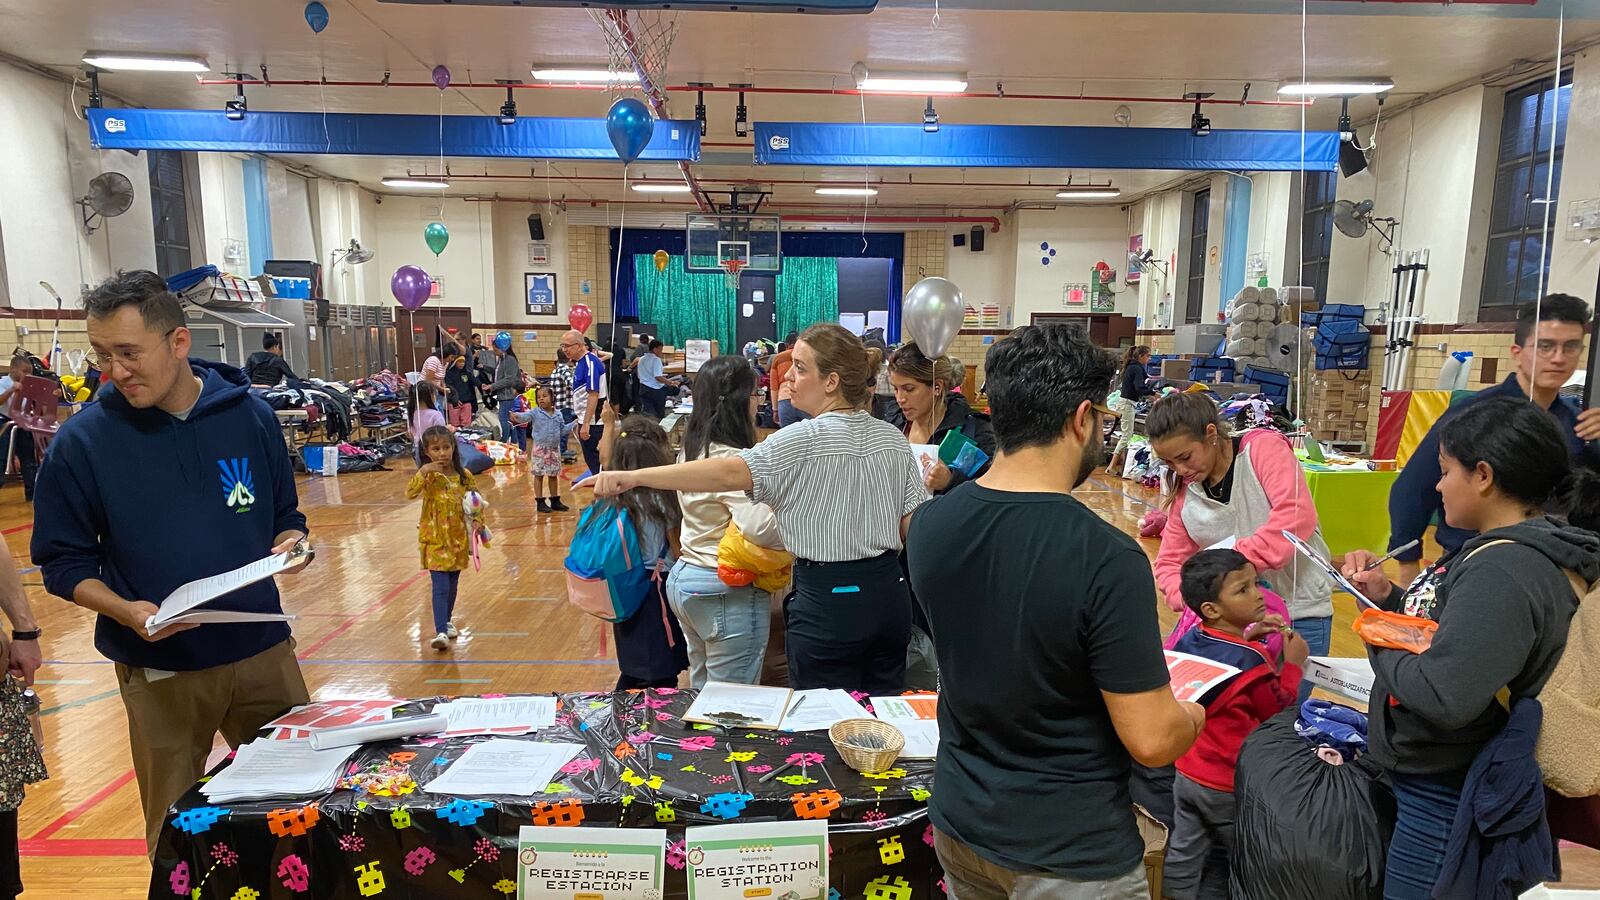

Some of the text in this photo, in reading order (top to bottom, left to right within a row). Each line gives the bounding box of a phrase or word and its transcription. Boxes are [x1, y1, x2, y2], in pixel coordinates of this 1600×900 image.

[772, 137, 788, 145] PSS
[536, 295, 547, 303] 32
[529, 869, 650, 881] REGISTRARSE
[695, 861, 818, 878] REGISTRATION
[546, 879, 632, 891] ESTACIÓN
[721, 873, 793, 888] STATION
